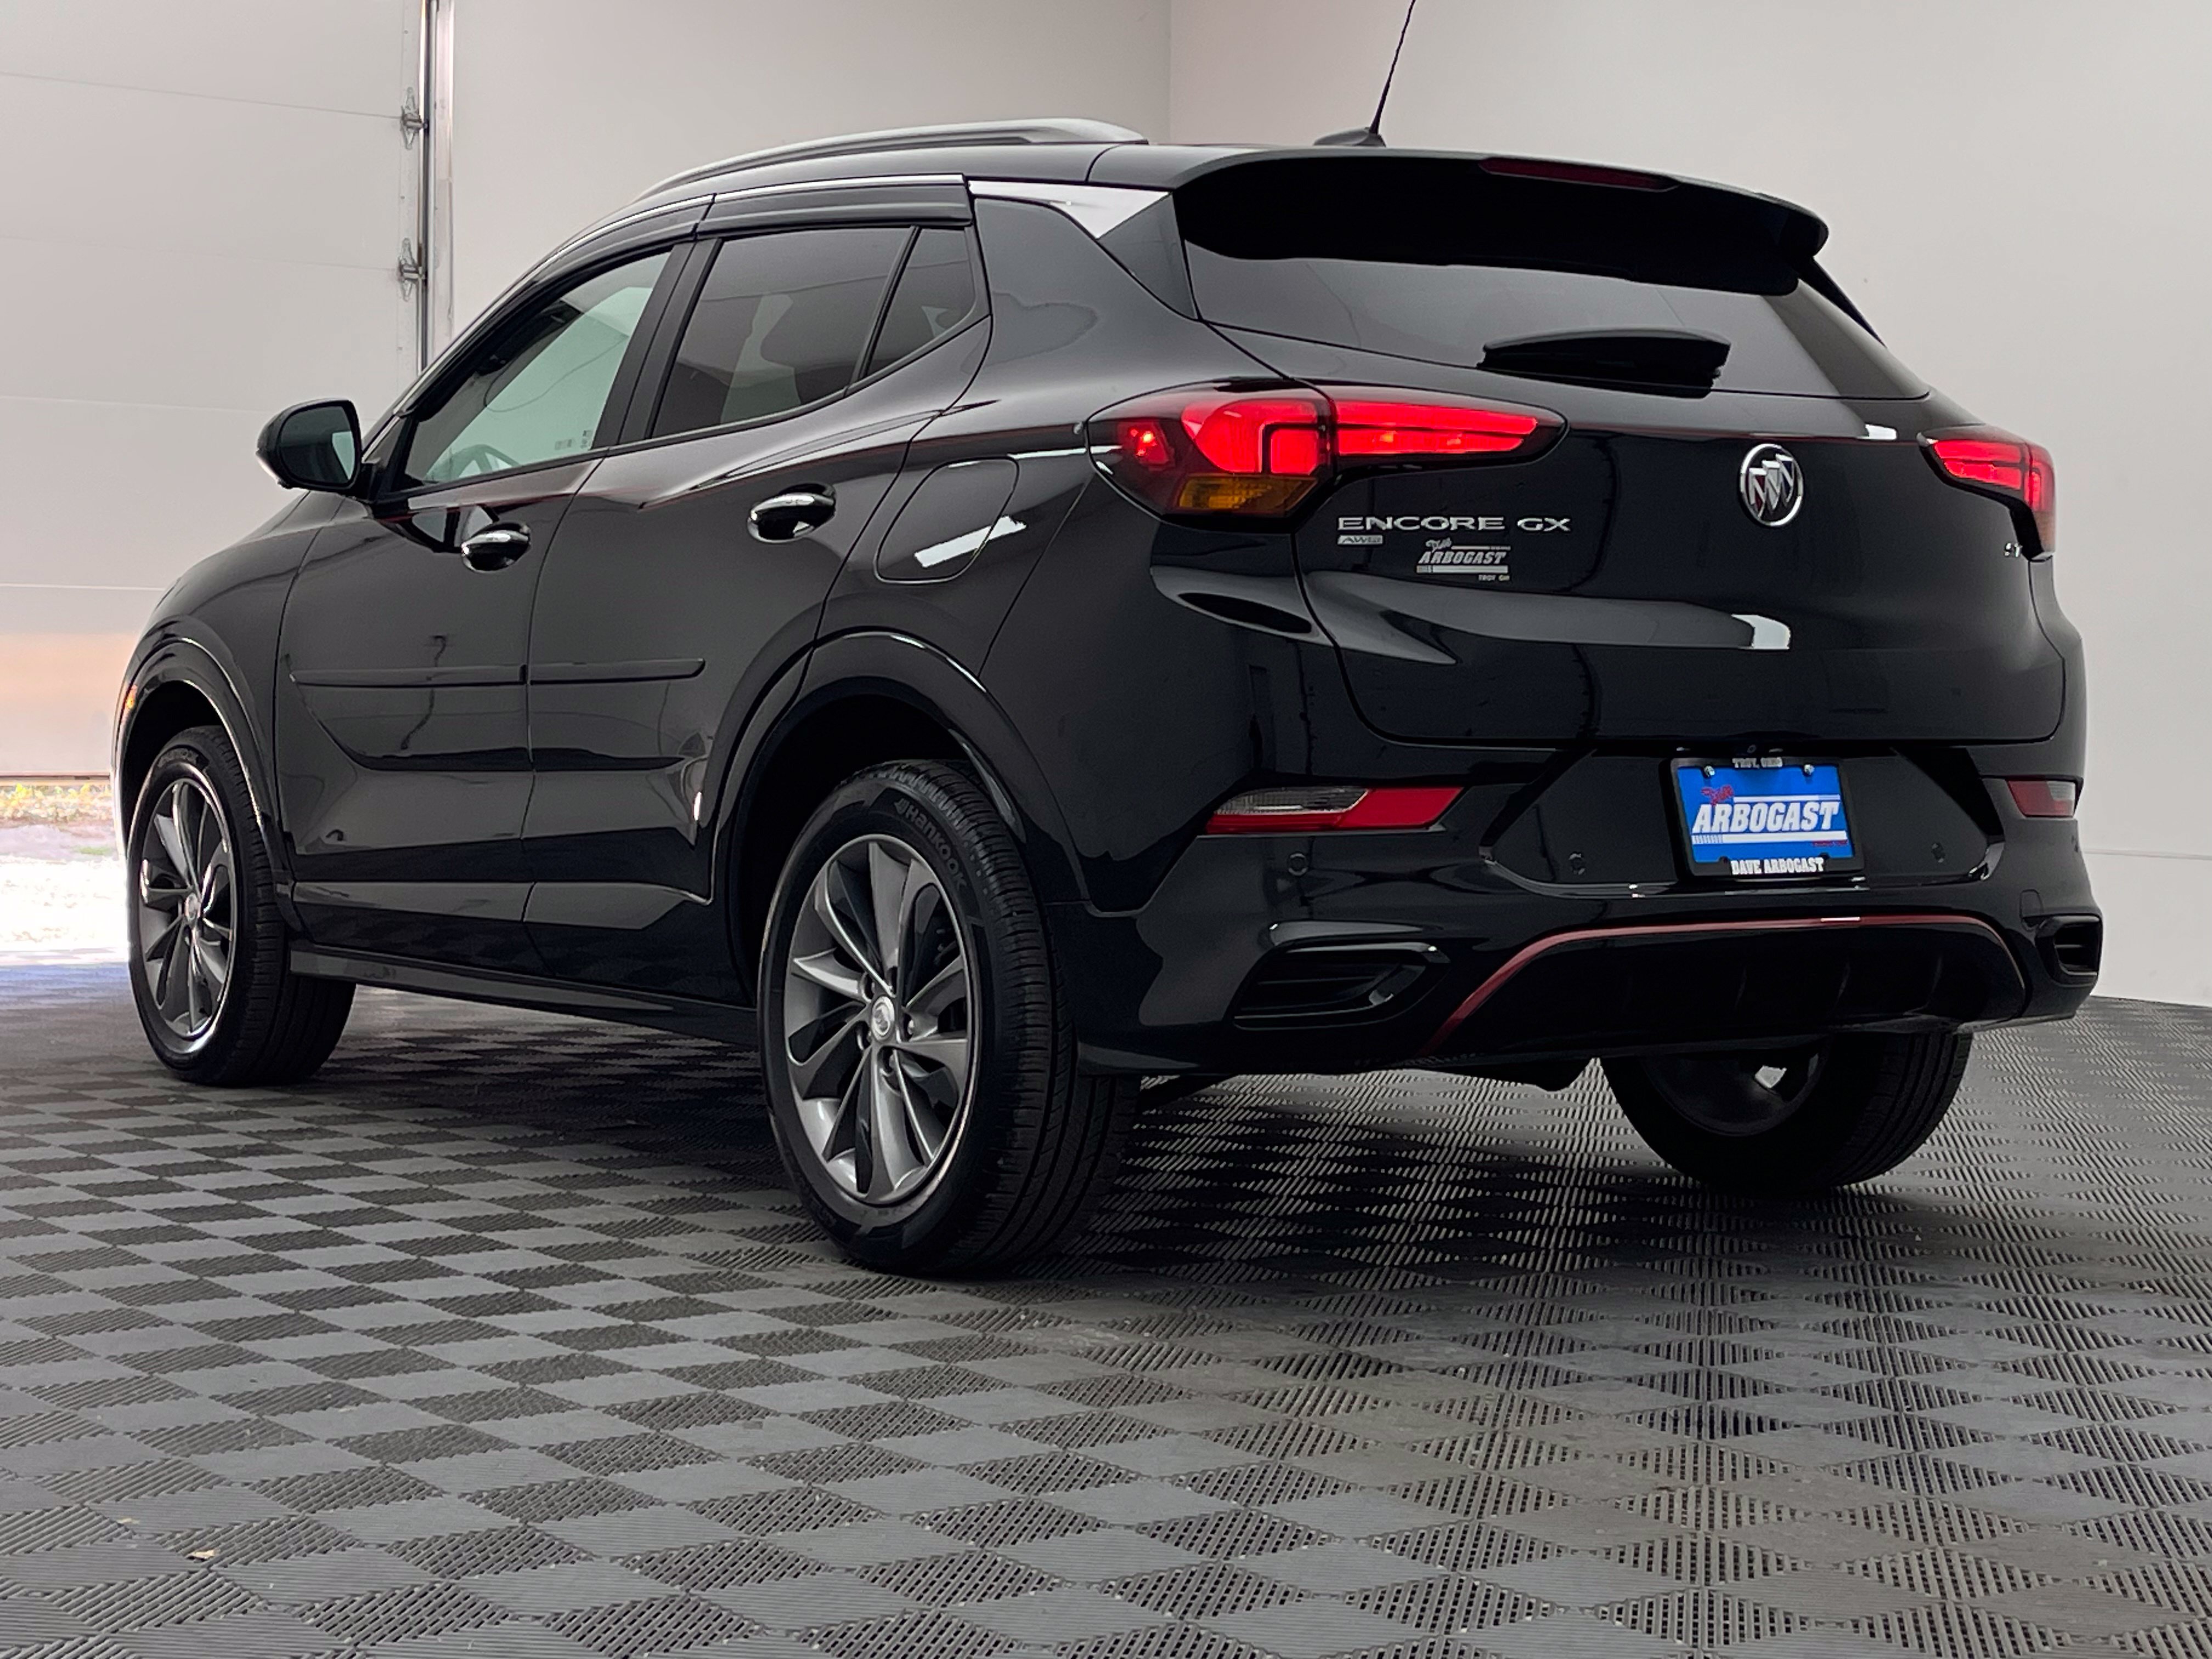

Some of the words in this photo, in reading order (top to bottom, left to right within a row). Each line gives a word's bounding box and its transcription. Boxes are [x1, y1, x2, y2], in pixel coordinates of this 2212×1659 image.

[1338, 516, 1505, 531] ENCORE
[1517, 517, 1571, 532] GX
[1418, 551, 1506, 564] ARBOGAST
[1692, 802, 1840, 833] ARBOGAST
[1731, 859, 1762, 875] DAVE
[1764, 857, 1824, 874] ARBOGAST
